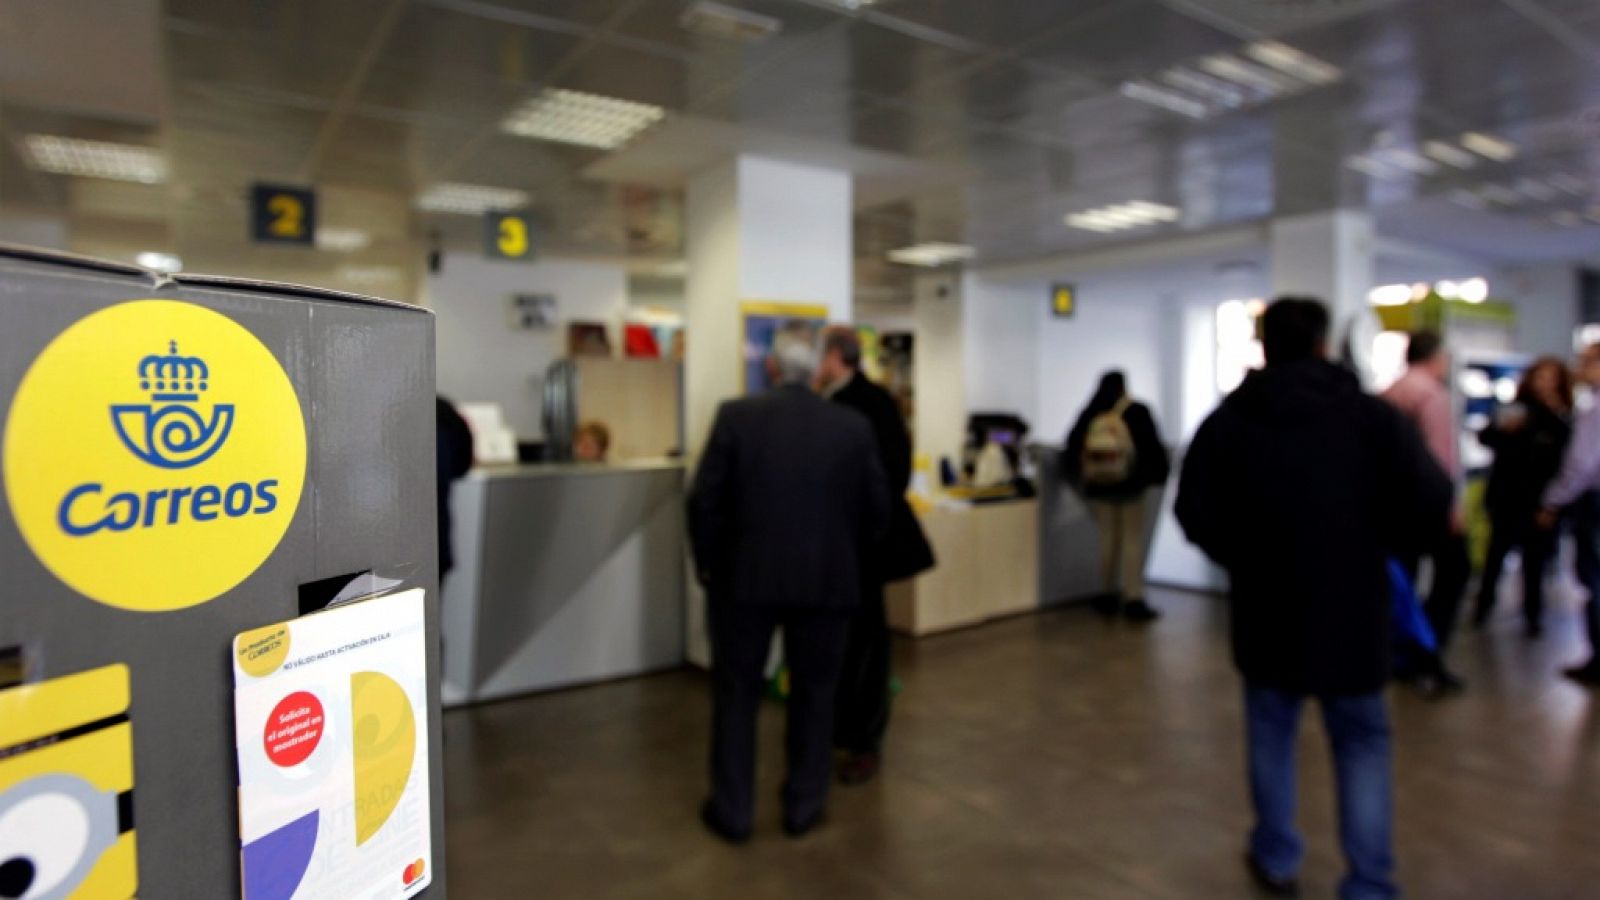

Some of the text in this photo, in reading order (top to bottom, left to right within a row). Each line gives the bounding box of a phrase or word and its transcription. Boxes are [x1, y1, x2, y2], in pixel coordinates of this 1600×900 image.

[266, 193, 303, 238] 2
[497, 216, 528, 257] 3
[58, 479, 279, 538] Correos
[283, 662, 293, 671] NO
[316, 649, 336, 660] HASTA
[279, 706, 310, 723] Solicita
[267, 715, 321, 742] el original en
[273, 729, 317, 753] mostrador
